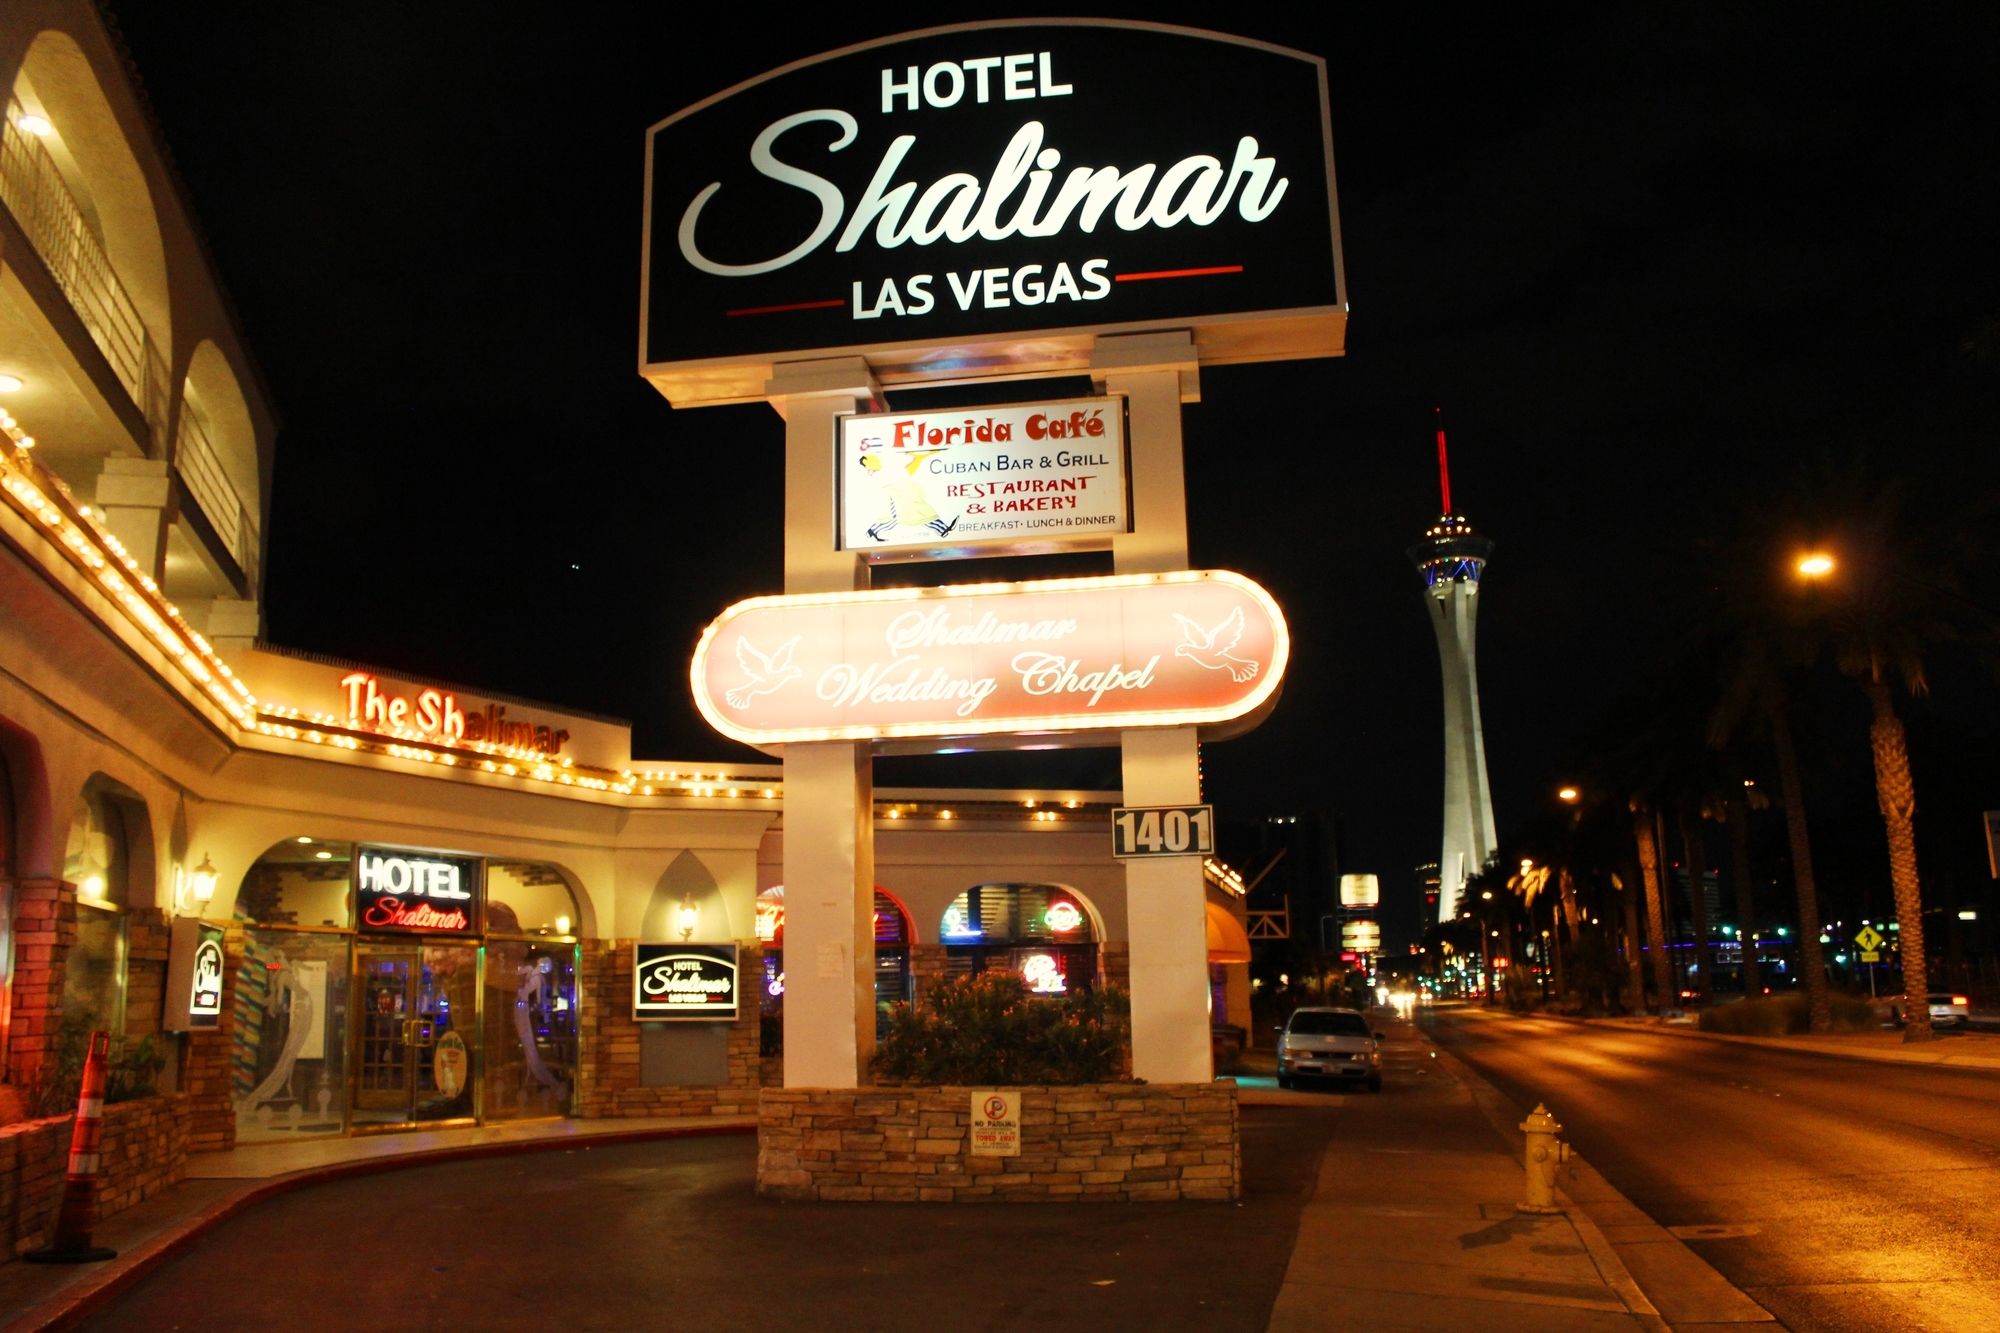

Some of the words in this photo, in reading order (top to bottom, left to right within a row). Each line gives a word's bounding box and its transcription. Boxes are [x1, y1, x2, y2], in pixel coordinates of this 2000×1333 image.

[880, 51, 1073, 113] HOTEL
[678, 108, 1290, 277] Shalimar
[851, 271, 935, 320] LAS
[946, 258, 1112, 312] VEGAS
[892, 417, 1014, 448] Florida
[1025, 409, 1106, 440] Café
[929, 458, 991, 475] CUBAN
[997, 455, 1033, 471] BAR
[1039, 456, 1052, 468] &
[1056, 451, 1110, 467] GRILL
[946, 475, 1097, 498] RESTAURANT
[966, 503, 987, 515] &
[993, 496, 1077, 513] BAKERY
[1026, 517, 1064, 529] LUNCH
[1065, 517, 1073, 526] &
[1075, 515, 1116, 525] DINNER
[885, 606, 1078, 657] Shalimar
[815, 654, 998, 716] Wedding
[1011, 650, 1161, 707] Chapel
[340, 673, 409, 728] The
[415, 688, 571, 755] Shalimar
[1116, 809, 1210, 853] 1401
[359, 855, 471, 900] HOTEL
[365, 896, 468, 929] Shalimar
[673, 961, 703, 971] HOTEL
